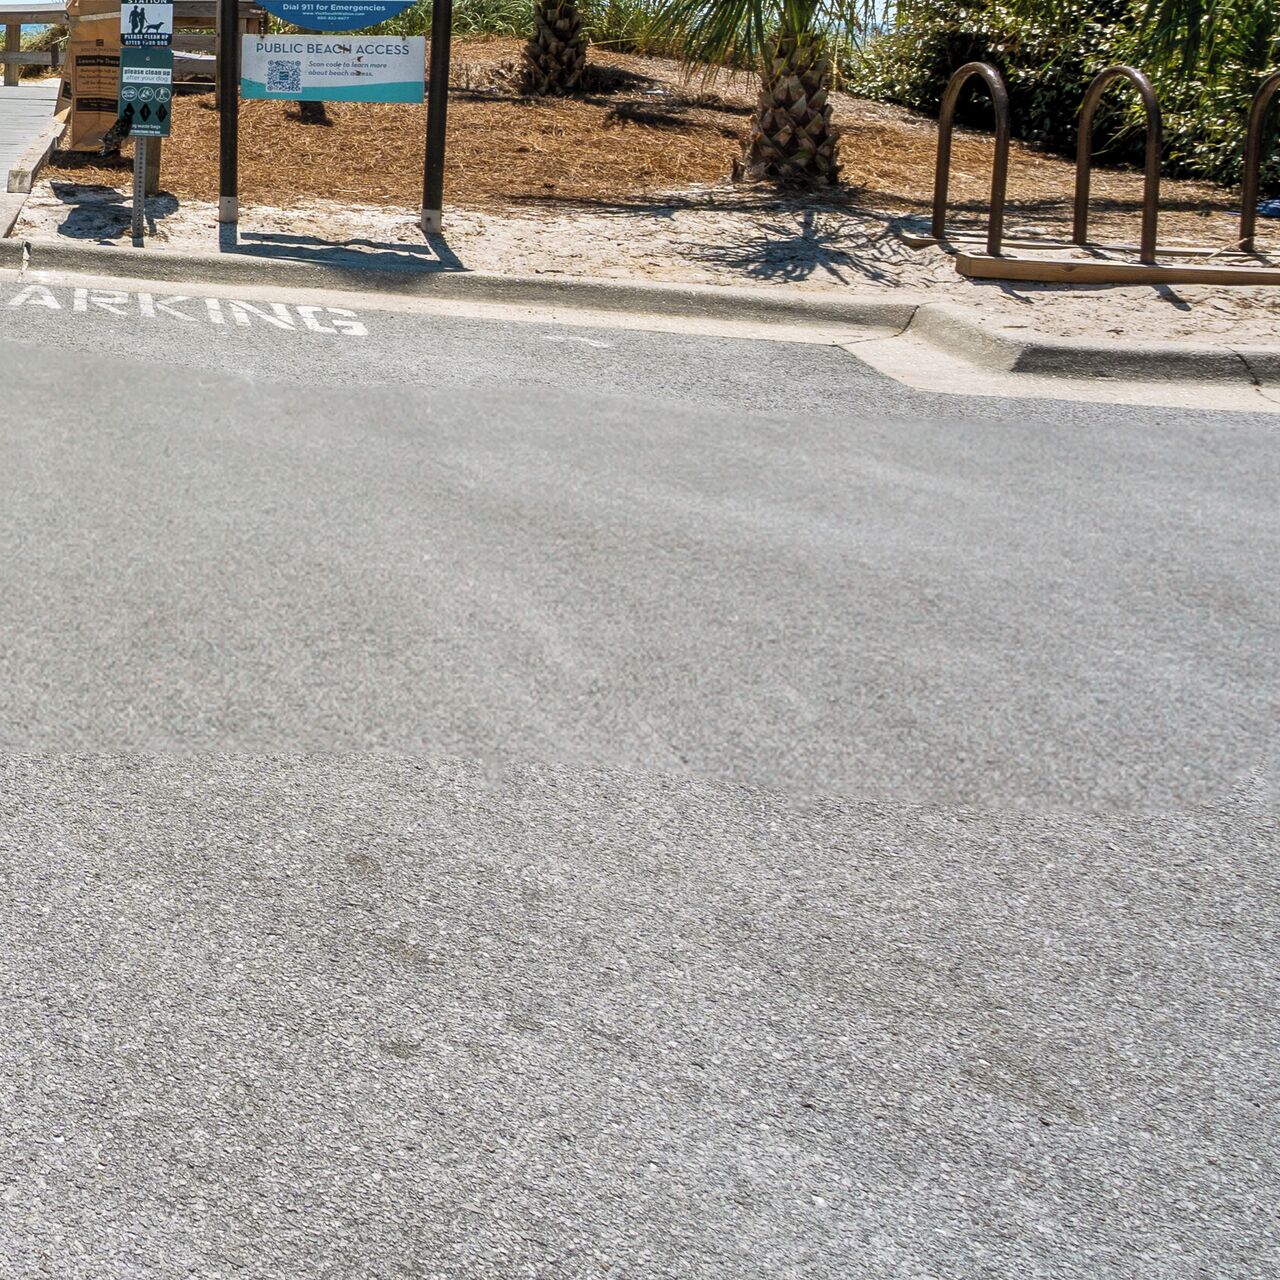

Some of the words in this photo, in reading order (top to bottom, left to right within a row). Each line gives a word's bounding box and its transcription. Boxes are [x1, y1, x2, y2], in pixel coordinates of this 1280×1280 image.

[282, 3, 299, 11] Dial
[301, 3, 314, 11] 911
[331, 4, 386, 12] Emergencies
[256, 43, 303, 54] PUBLIC
[307, 43, 352, 54] BEACH
[356, 44, 410, 55] ACCESS
